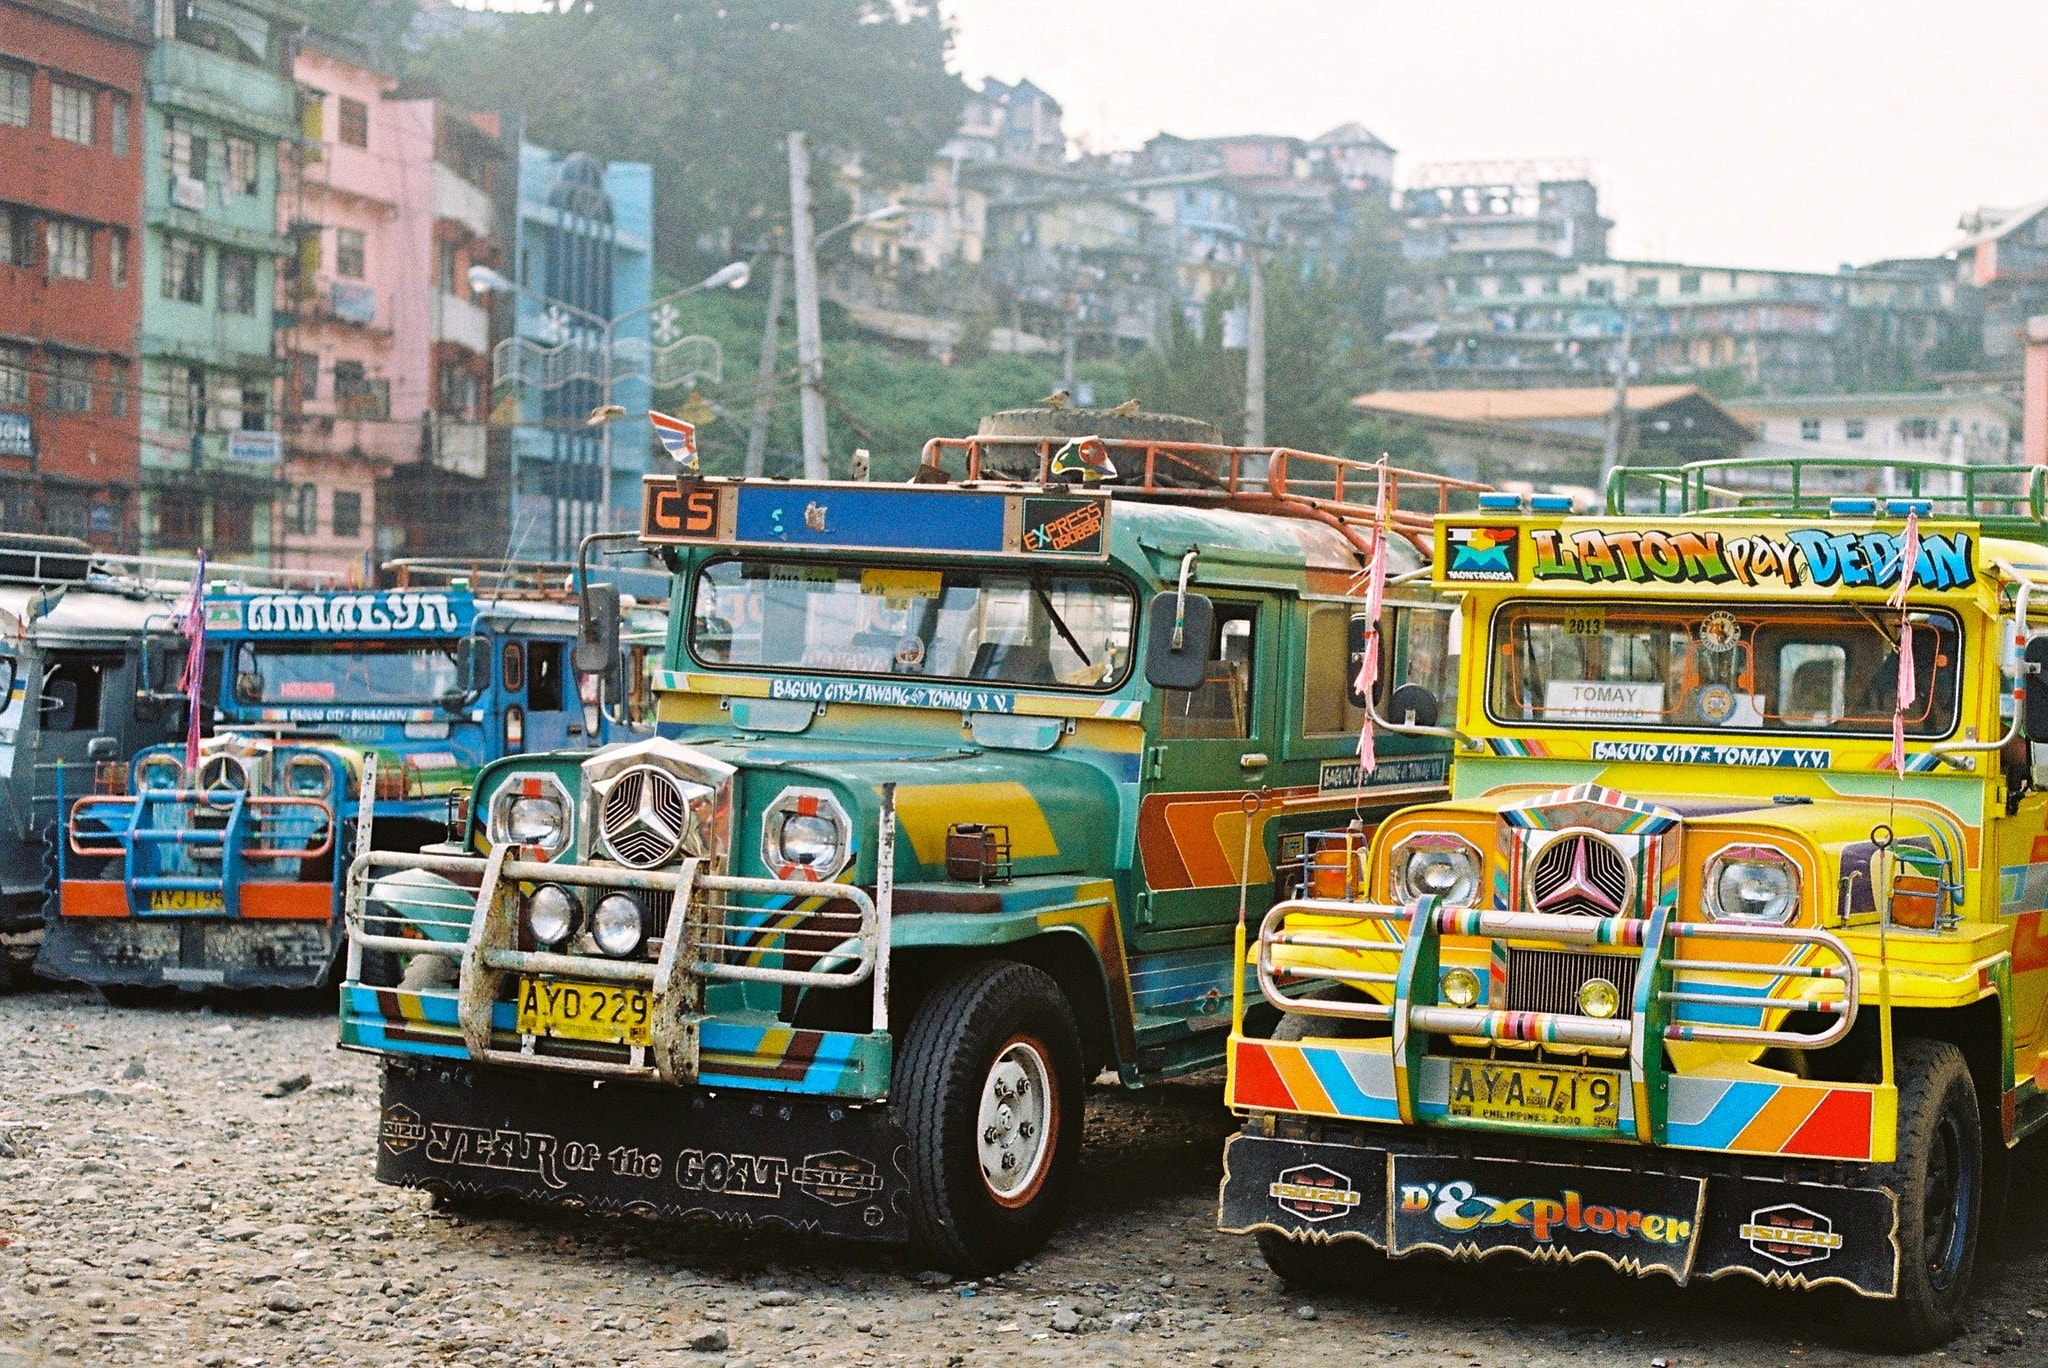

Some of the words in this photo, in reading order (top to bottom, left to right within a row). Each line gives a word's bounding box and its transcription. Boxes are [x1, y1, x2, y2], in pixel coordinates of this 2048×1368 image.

[656, 491, 713, 531] CS
[1023, 502, 1102, 551] EXPRESS
[1530, 529, 1732, 585] LATON
[1786, 529, 1975, 591] DEDAN
[1569, 618, 1601, 635] 2013
[1103, 663, 1114, 683] 2
[773, 679, 822, 700] BAGUIO
[927, 688, 972, 711] TOMAY
[1573, 686, 1638, 703] TOMAY
[1595, 742, 1659, 761] BAGUIO
[1662, 745, 1701, 763] CITY
[1714, 748, 1784, 767] TOMAY
[1482, 1108, 1548, 1123] PHILIPPINES
[427, 1122, 567, 1189] YEAR
[607, 1145, 663, 1179] the
[676, 1148, 789, 1199] GOAT
[792, 1167, 884, 1191] ISUZU
[1270, 1183, 1360, 1205] ISUZU
[1400, 1180, 1692, 1245] D'Explorer
[1741, 1224, 1842, 1249] ISUZU
